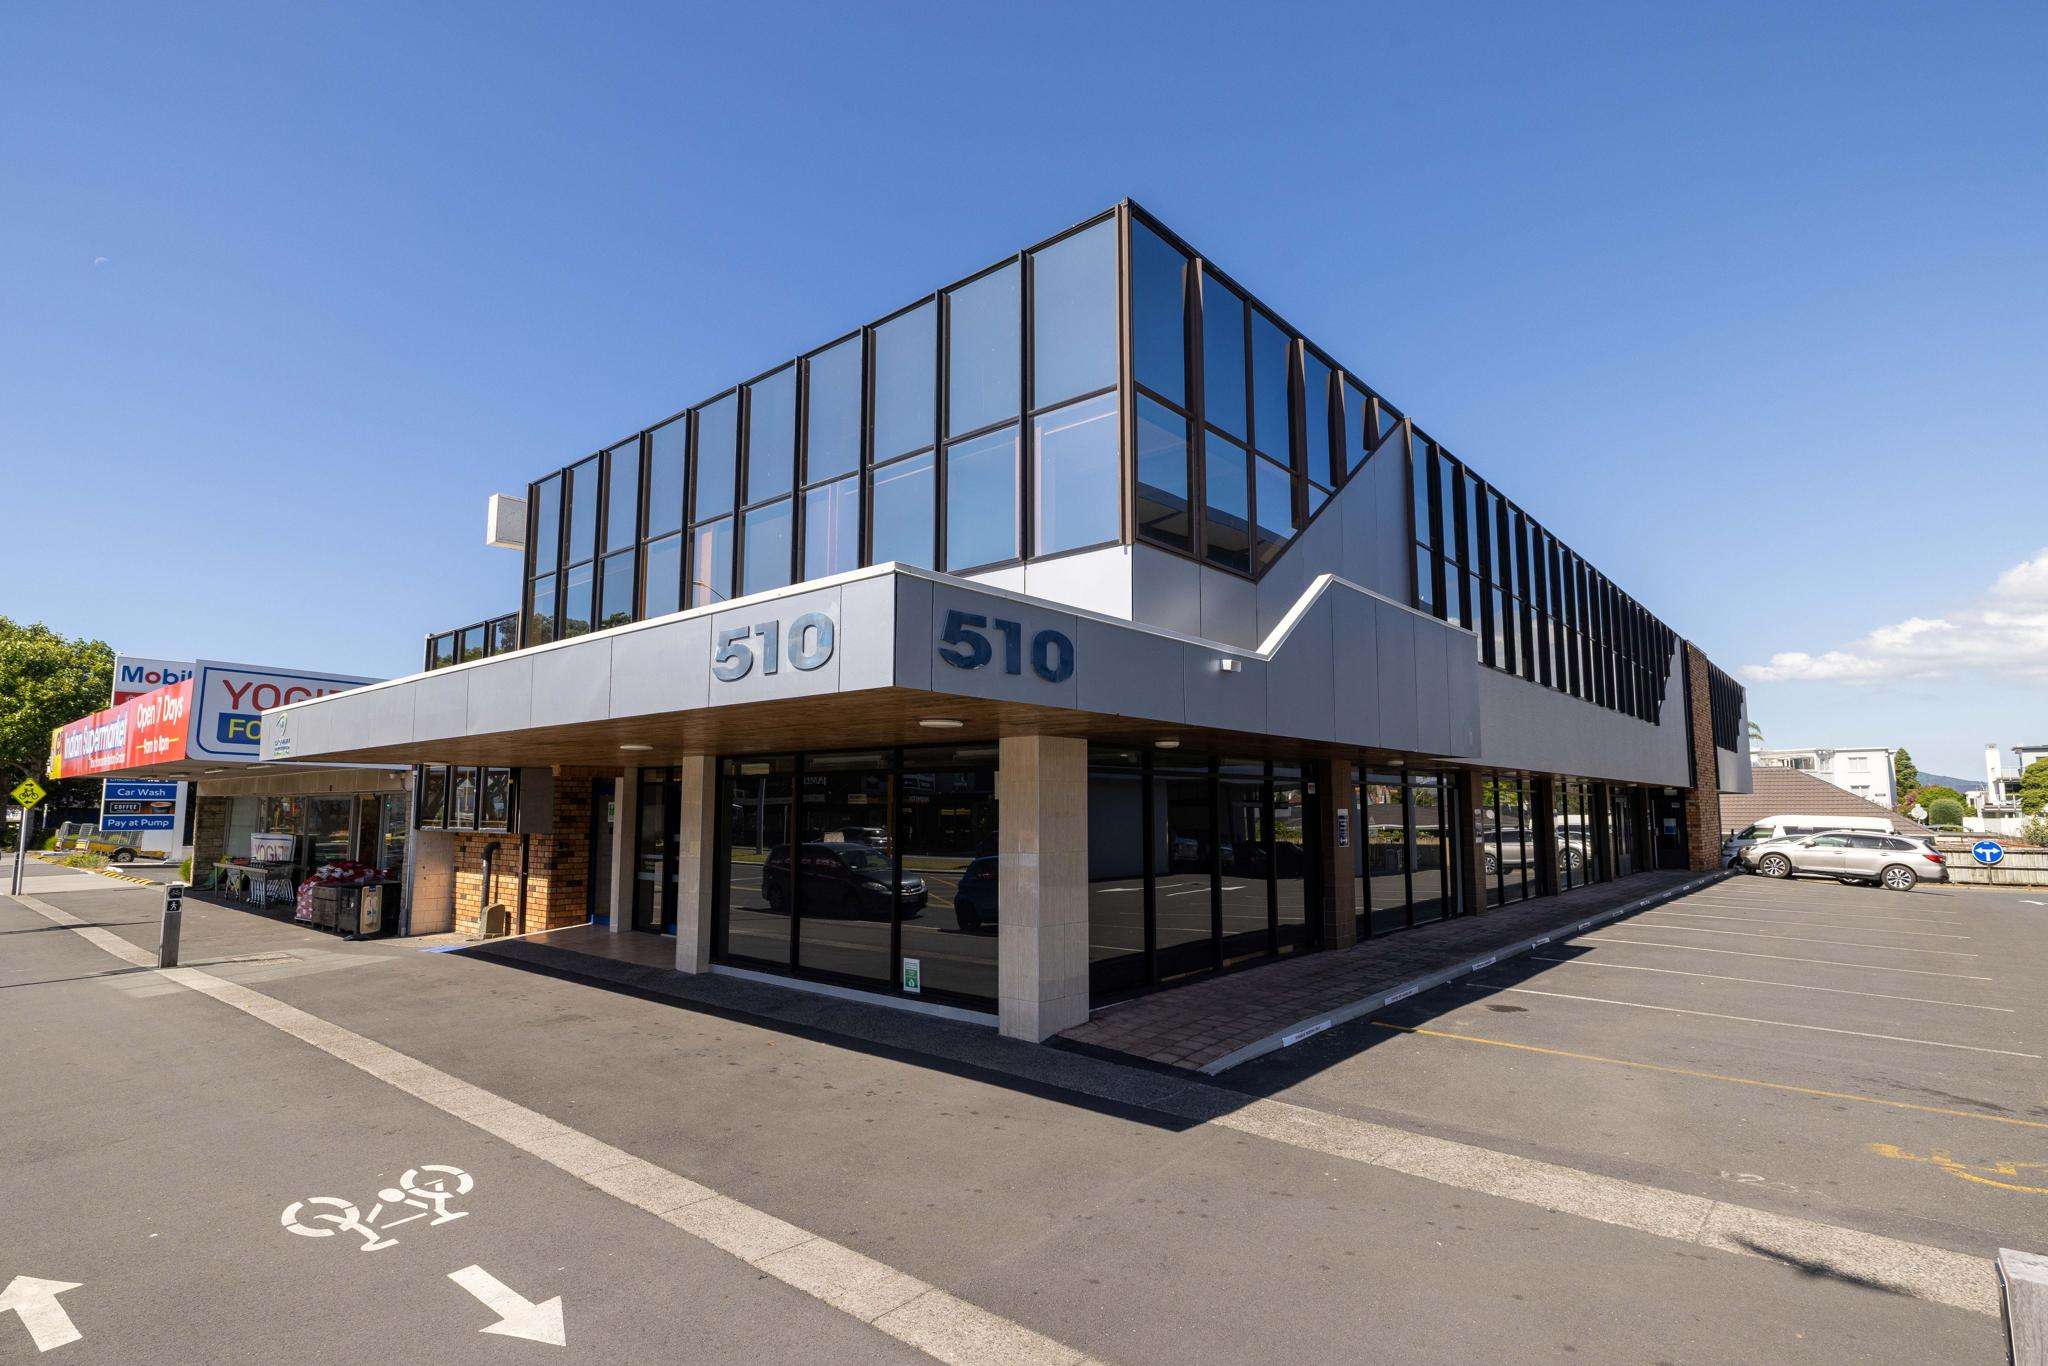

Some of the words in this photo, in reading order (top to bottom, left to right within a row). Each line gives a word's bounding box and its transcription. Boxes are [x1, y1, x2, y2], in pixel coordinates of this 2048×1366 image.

[712, 611, 834, 682] 510
[937, 608, 1075, 683] 510
[83, 711, 128, 757] Supermarket
[137, 704, 156, 732] Open
[156, 696, 163, 723] 7
[163, 694, 184, 725] Days
[117, 788, 135, 796] Car
[138, 788, 166, 796] Wash
[107, 819, 129, 829] Pay
[141, 819, 169, 828] Pump
